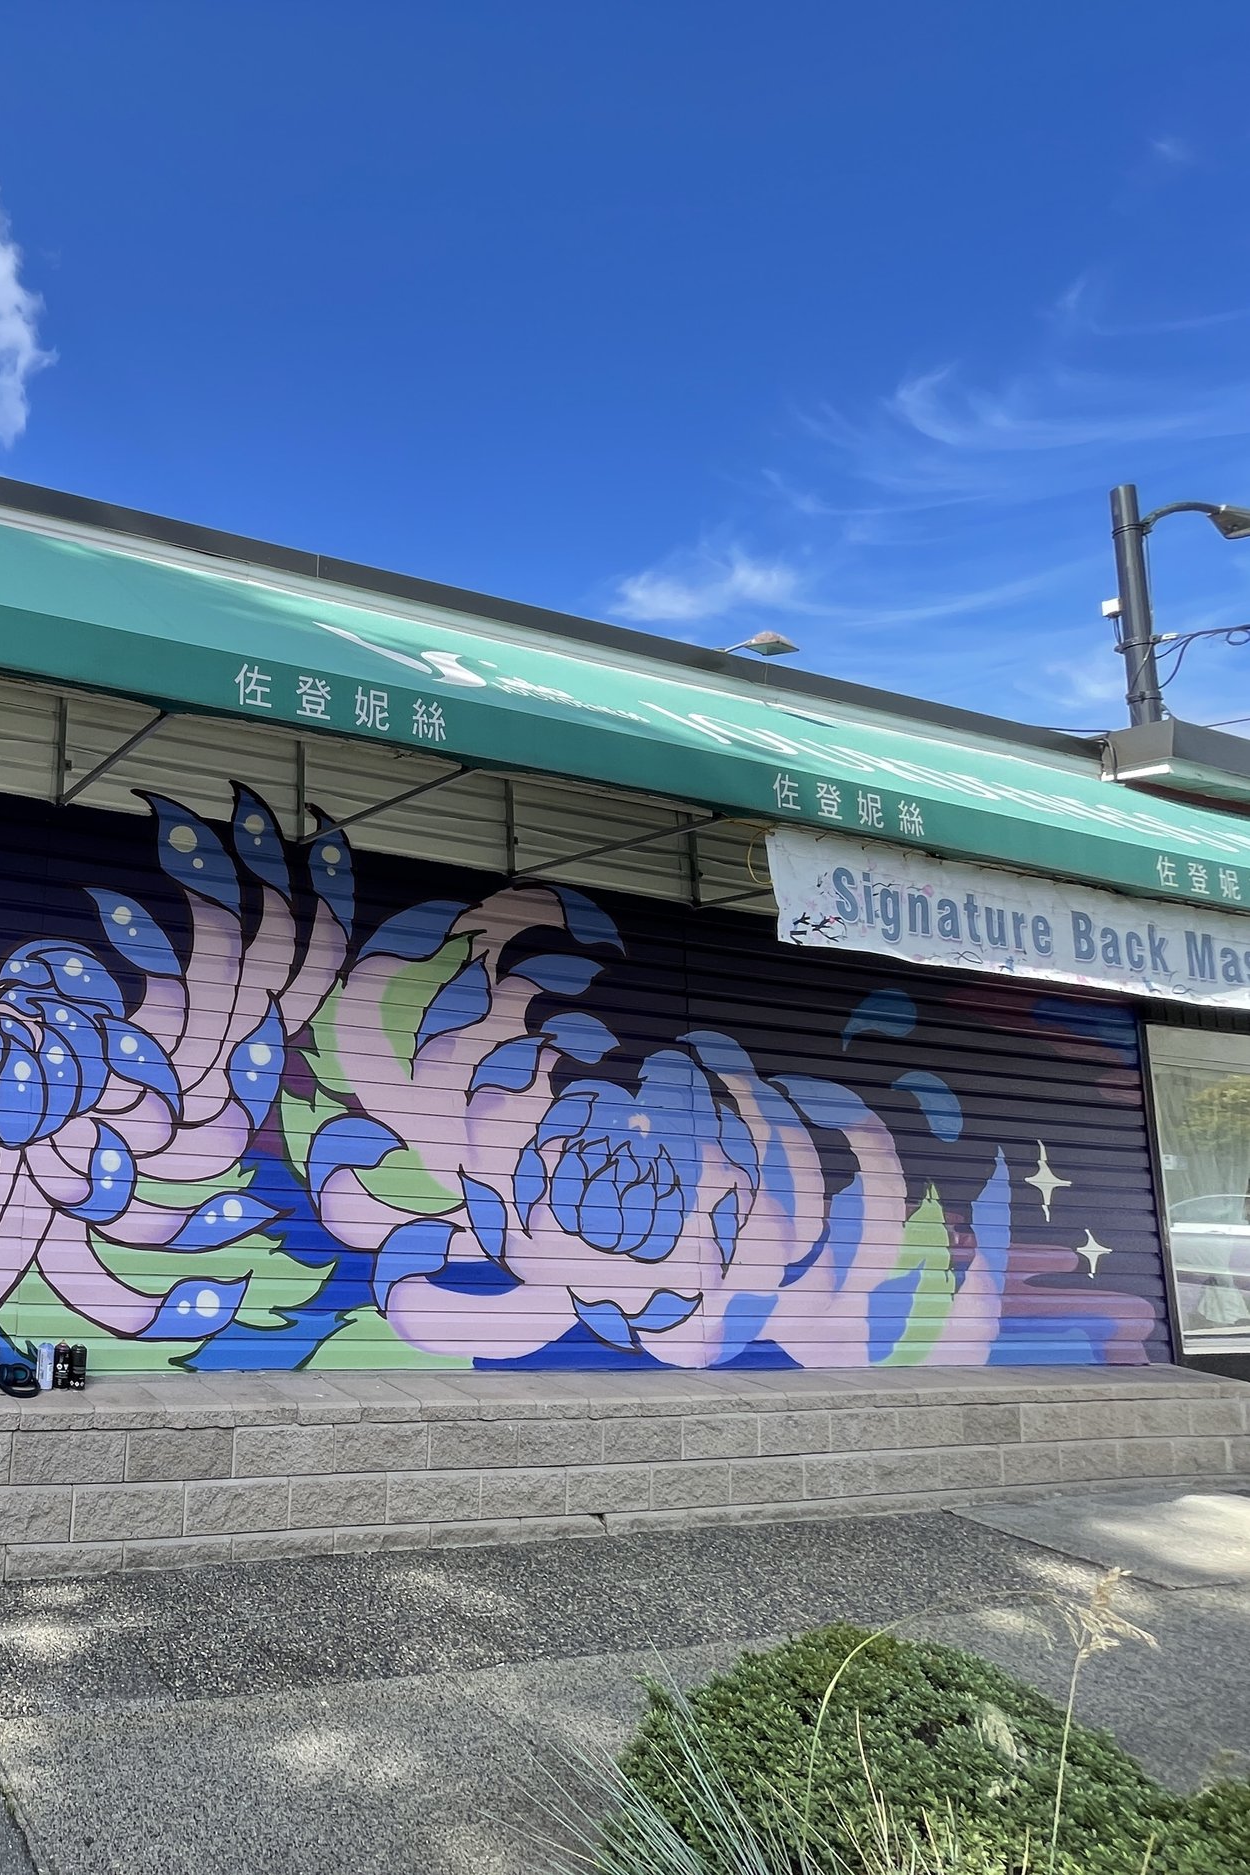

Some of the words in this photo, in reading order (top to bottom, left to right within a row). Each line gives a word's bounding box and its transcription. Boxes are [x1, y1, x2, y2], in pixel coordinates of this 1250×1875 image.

[233, 662, 447, 742] 佐登妮絲
[772, 772, 926, 838] 佐登妮絲
[1155, 854, 1250, 901] 佐登妮
[831, 865, 1053, 956] Signature
[1070, 910, 1171, 975] Back
